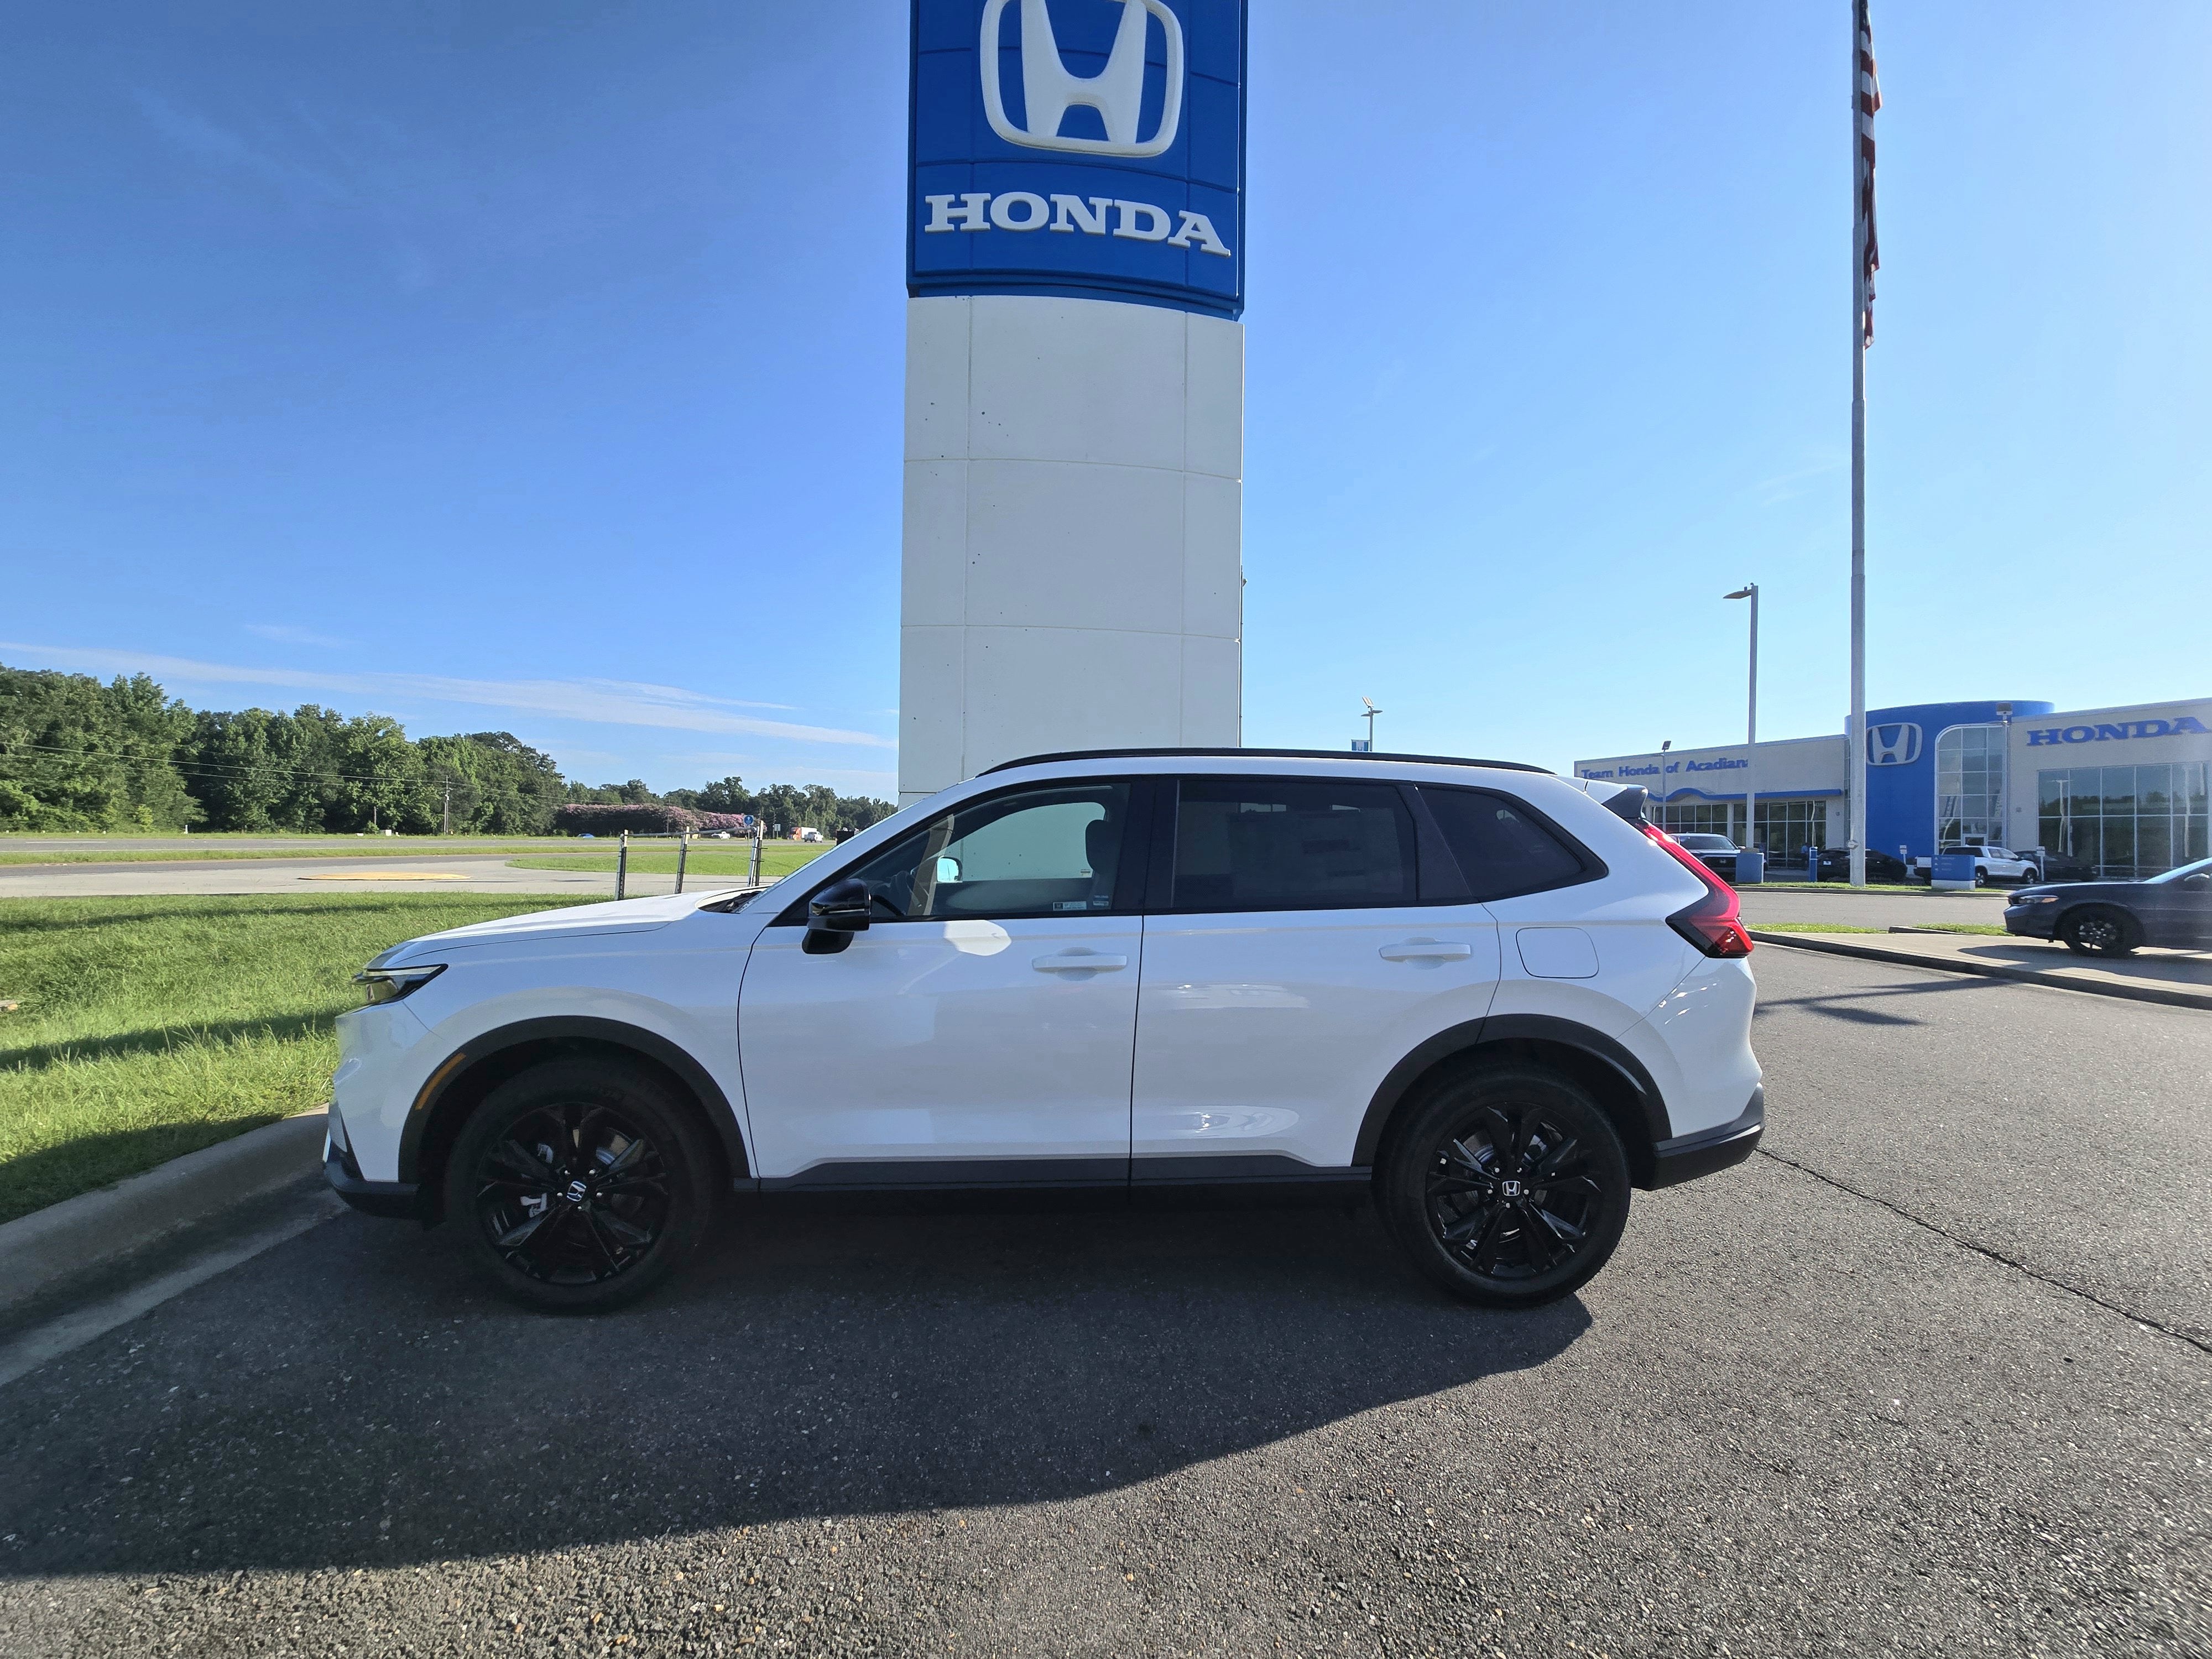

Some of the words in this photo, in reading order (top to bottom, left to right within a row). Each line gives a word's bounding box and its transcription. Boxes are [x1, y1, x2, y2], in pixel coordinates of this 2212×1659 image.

[925, 191, 1231, 257] HONDA
[2027, 717, 2211, 747] HONDA
[1581, 769, 1614, 779] Team
[1619, 764, 1661, 776] Honda
[1666, 761, 1681, 773] of
